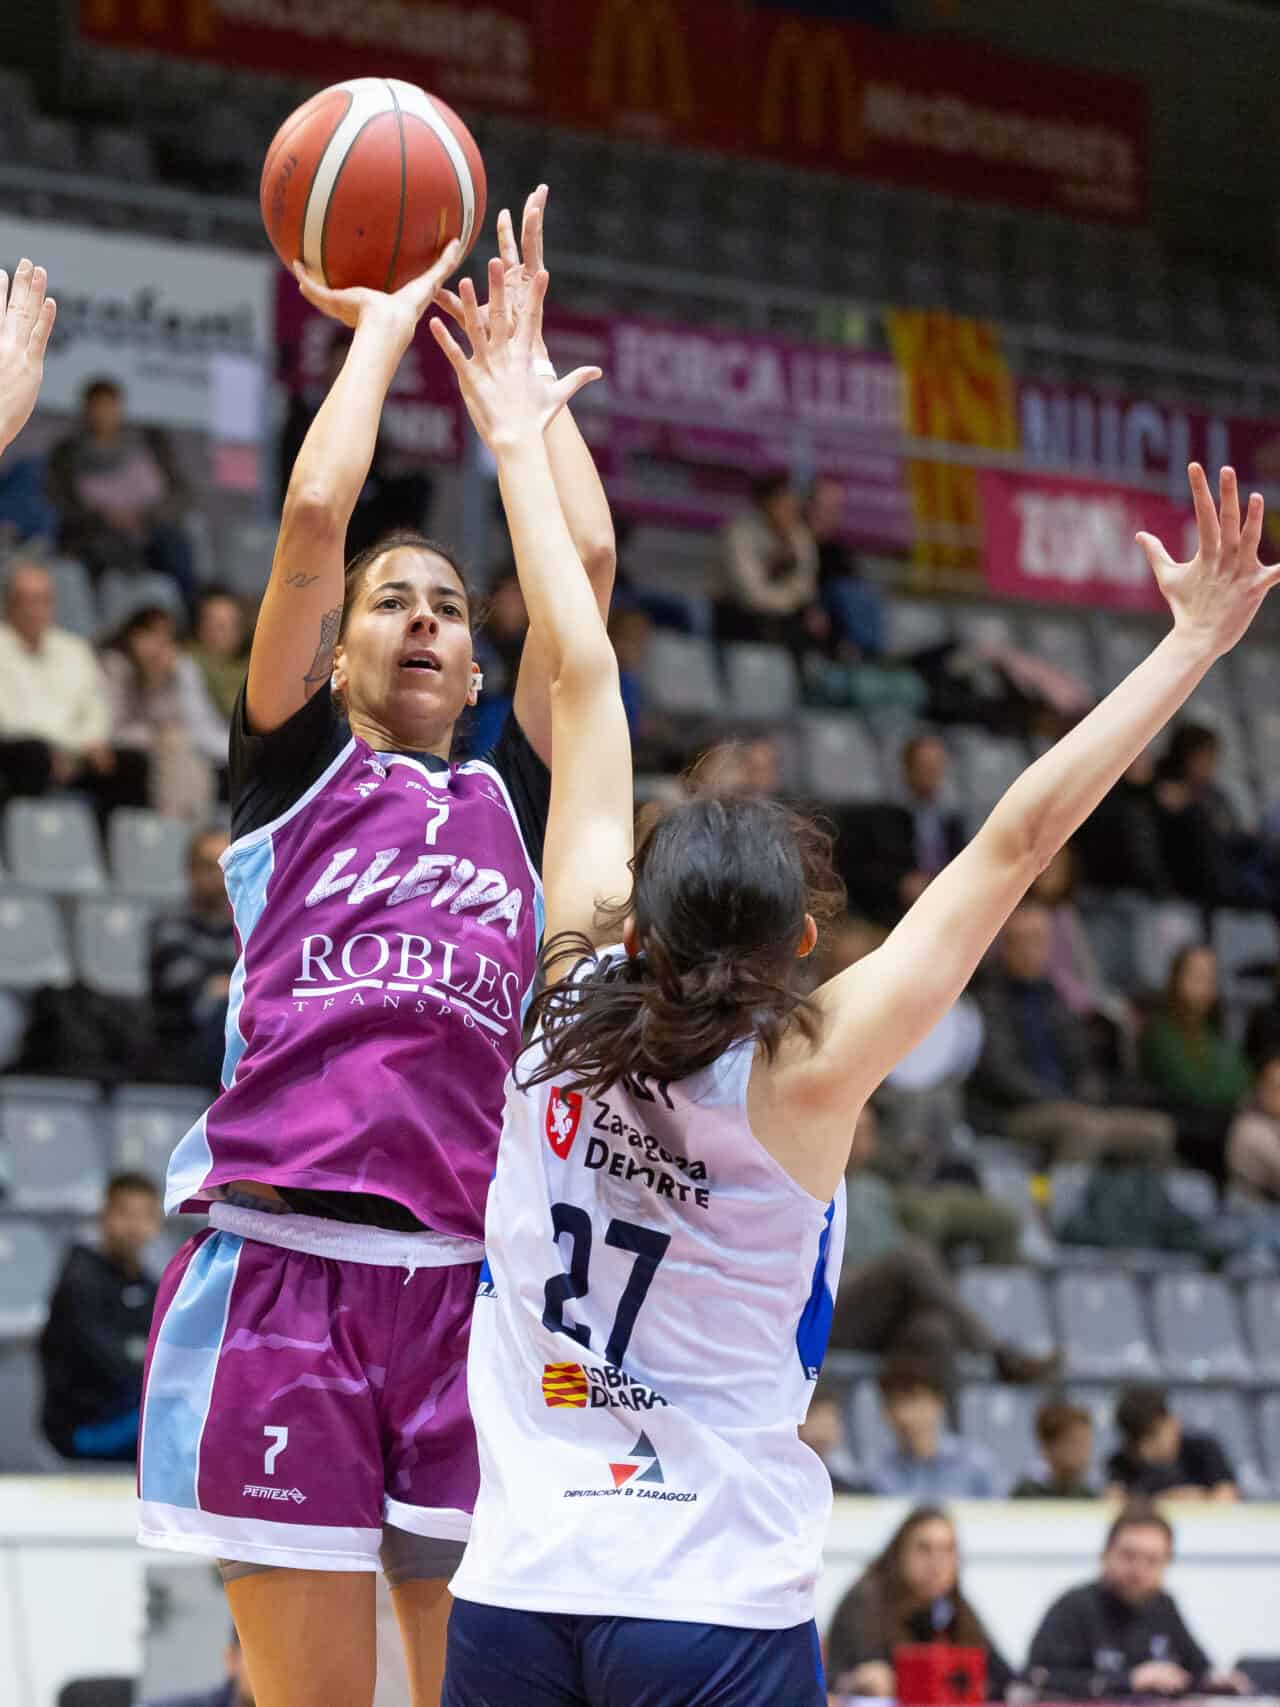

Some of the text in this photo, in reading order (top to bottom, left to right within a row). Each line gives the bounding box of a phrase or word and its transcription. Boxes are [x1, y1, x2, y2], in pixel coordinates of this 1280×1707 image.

[425, 800, 449, 845] 7
[305, 848, 522, 938] LLEIDA
[294, 933, 519, 1020] ROBLES
[593, 1100, 707, 1180] Zaagoza
[542, 1202, 672, 1368] 27
[264, 1425, 288, 1474] 7
[637, 1489, 697, 1502] ZARAGOZA
